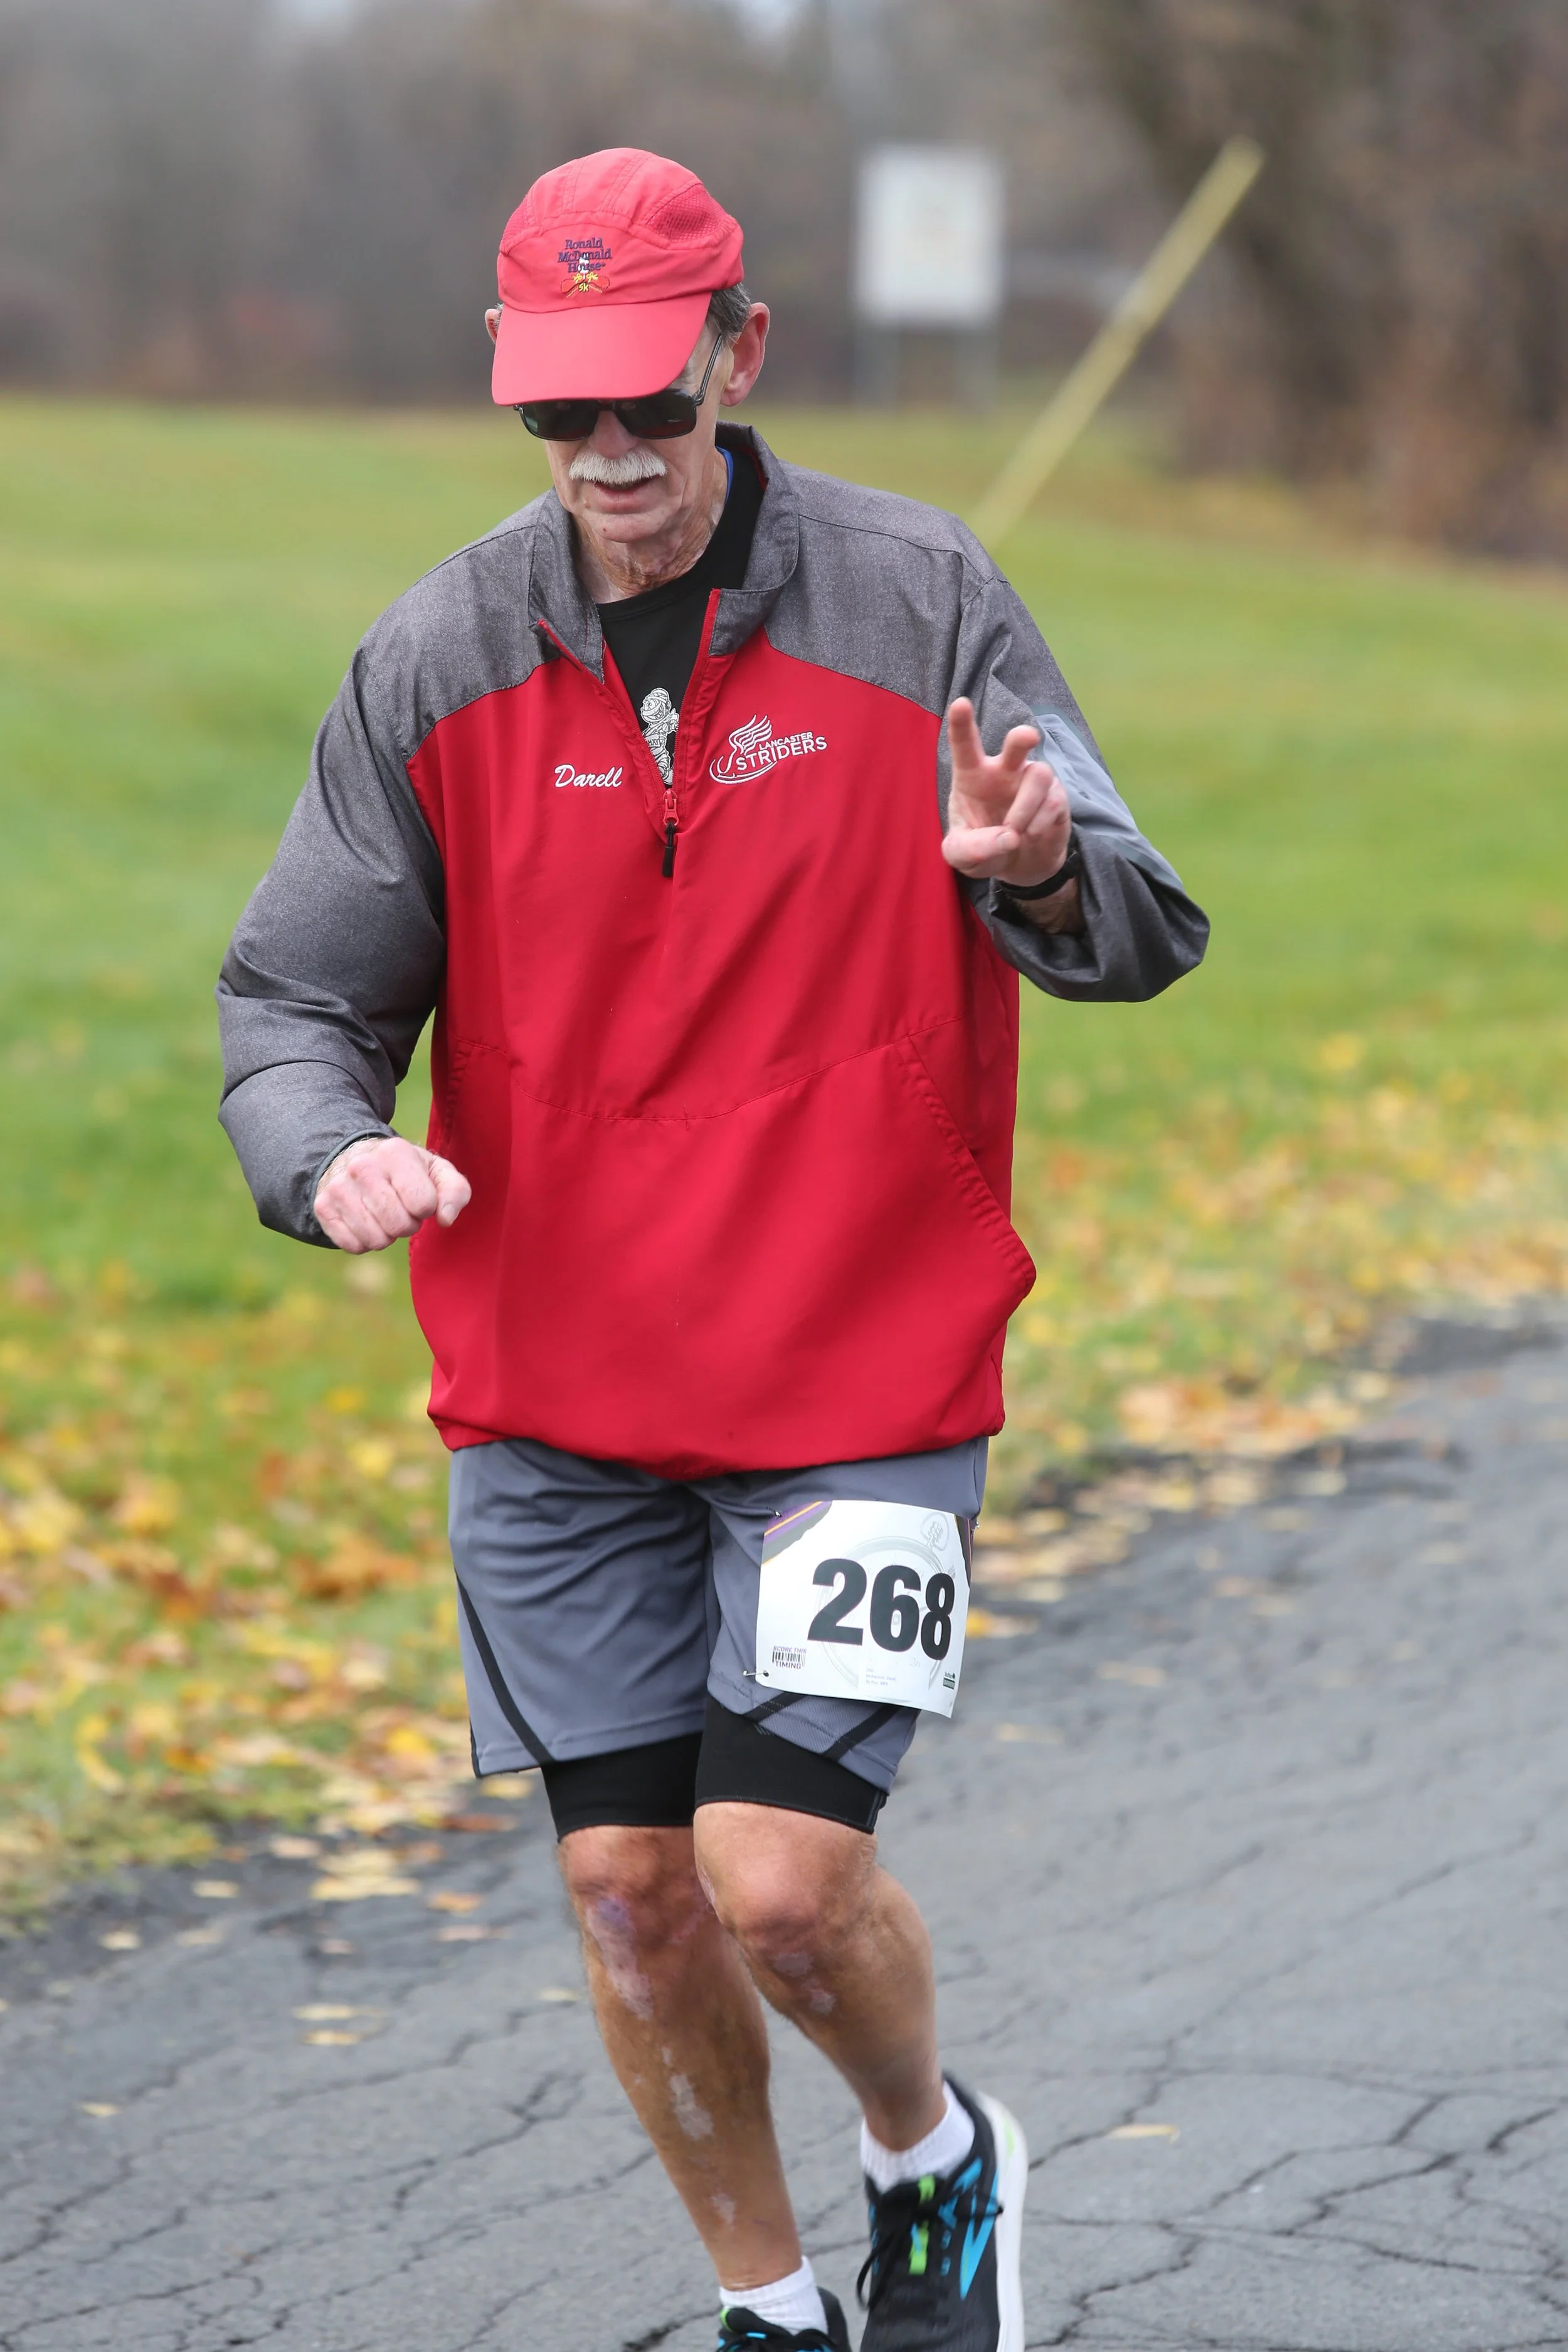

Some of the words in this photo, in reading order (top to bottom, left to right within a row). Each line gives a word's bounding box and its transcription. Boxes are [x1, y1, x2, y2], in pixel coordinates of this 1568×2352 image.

[565, 238, 603, 250] Ronald
[557, 248, 612, 262] McDonald
[759, 731, 813, 750] LANCASTER
[736, 736, 827, 771] STRIDERS
[554, 764, 623, 788] Darell
[807, 1558, 955, 1661] 268
[775, 1661, 801, 1669] TIMING
